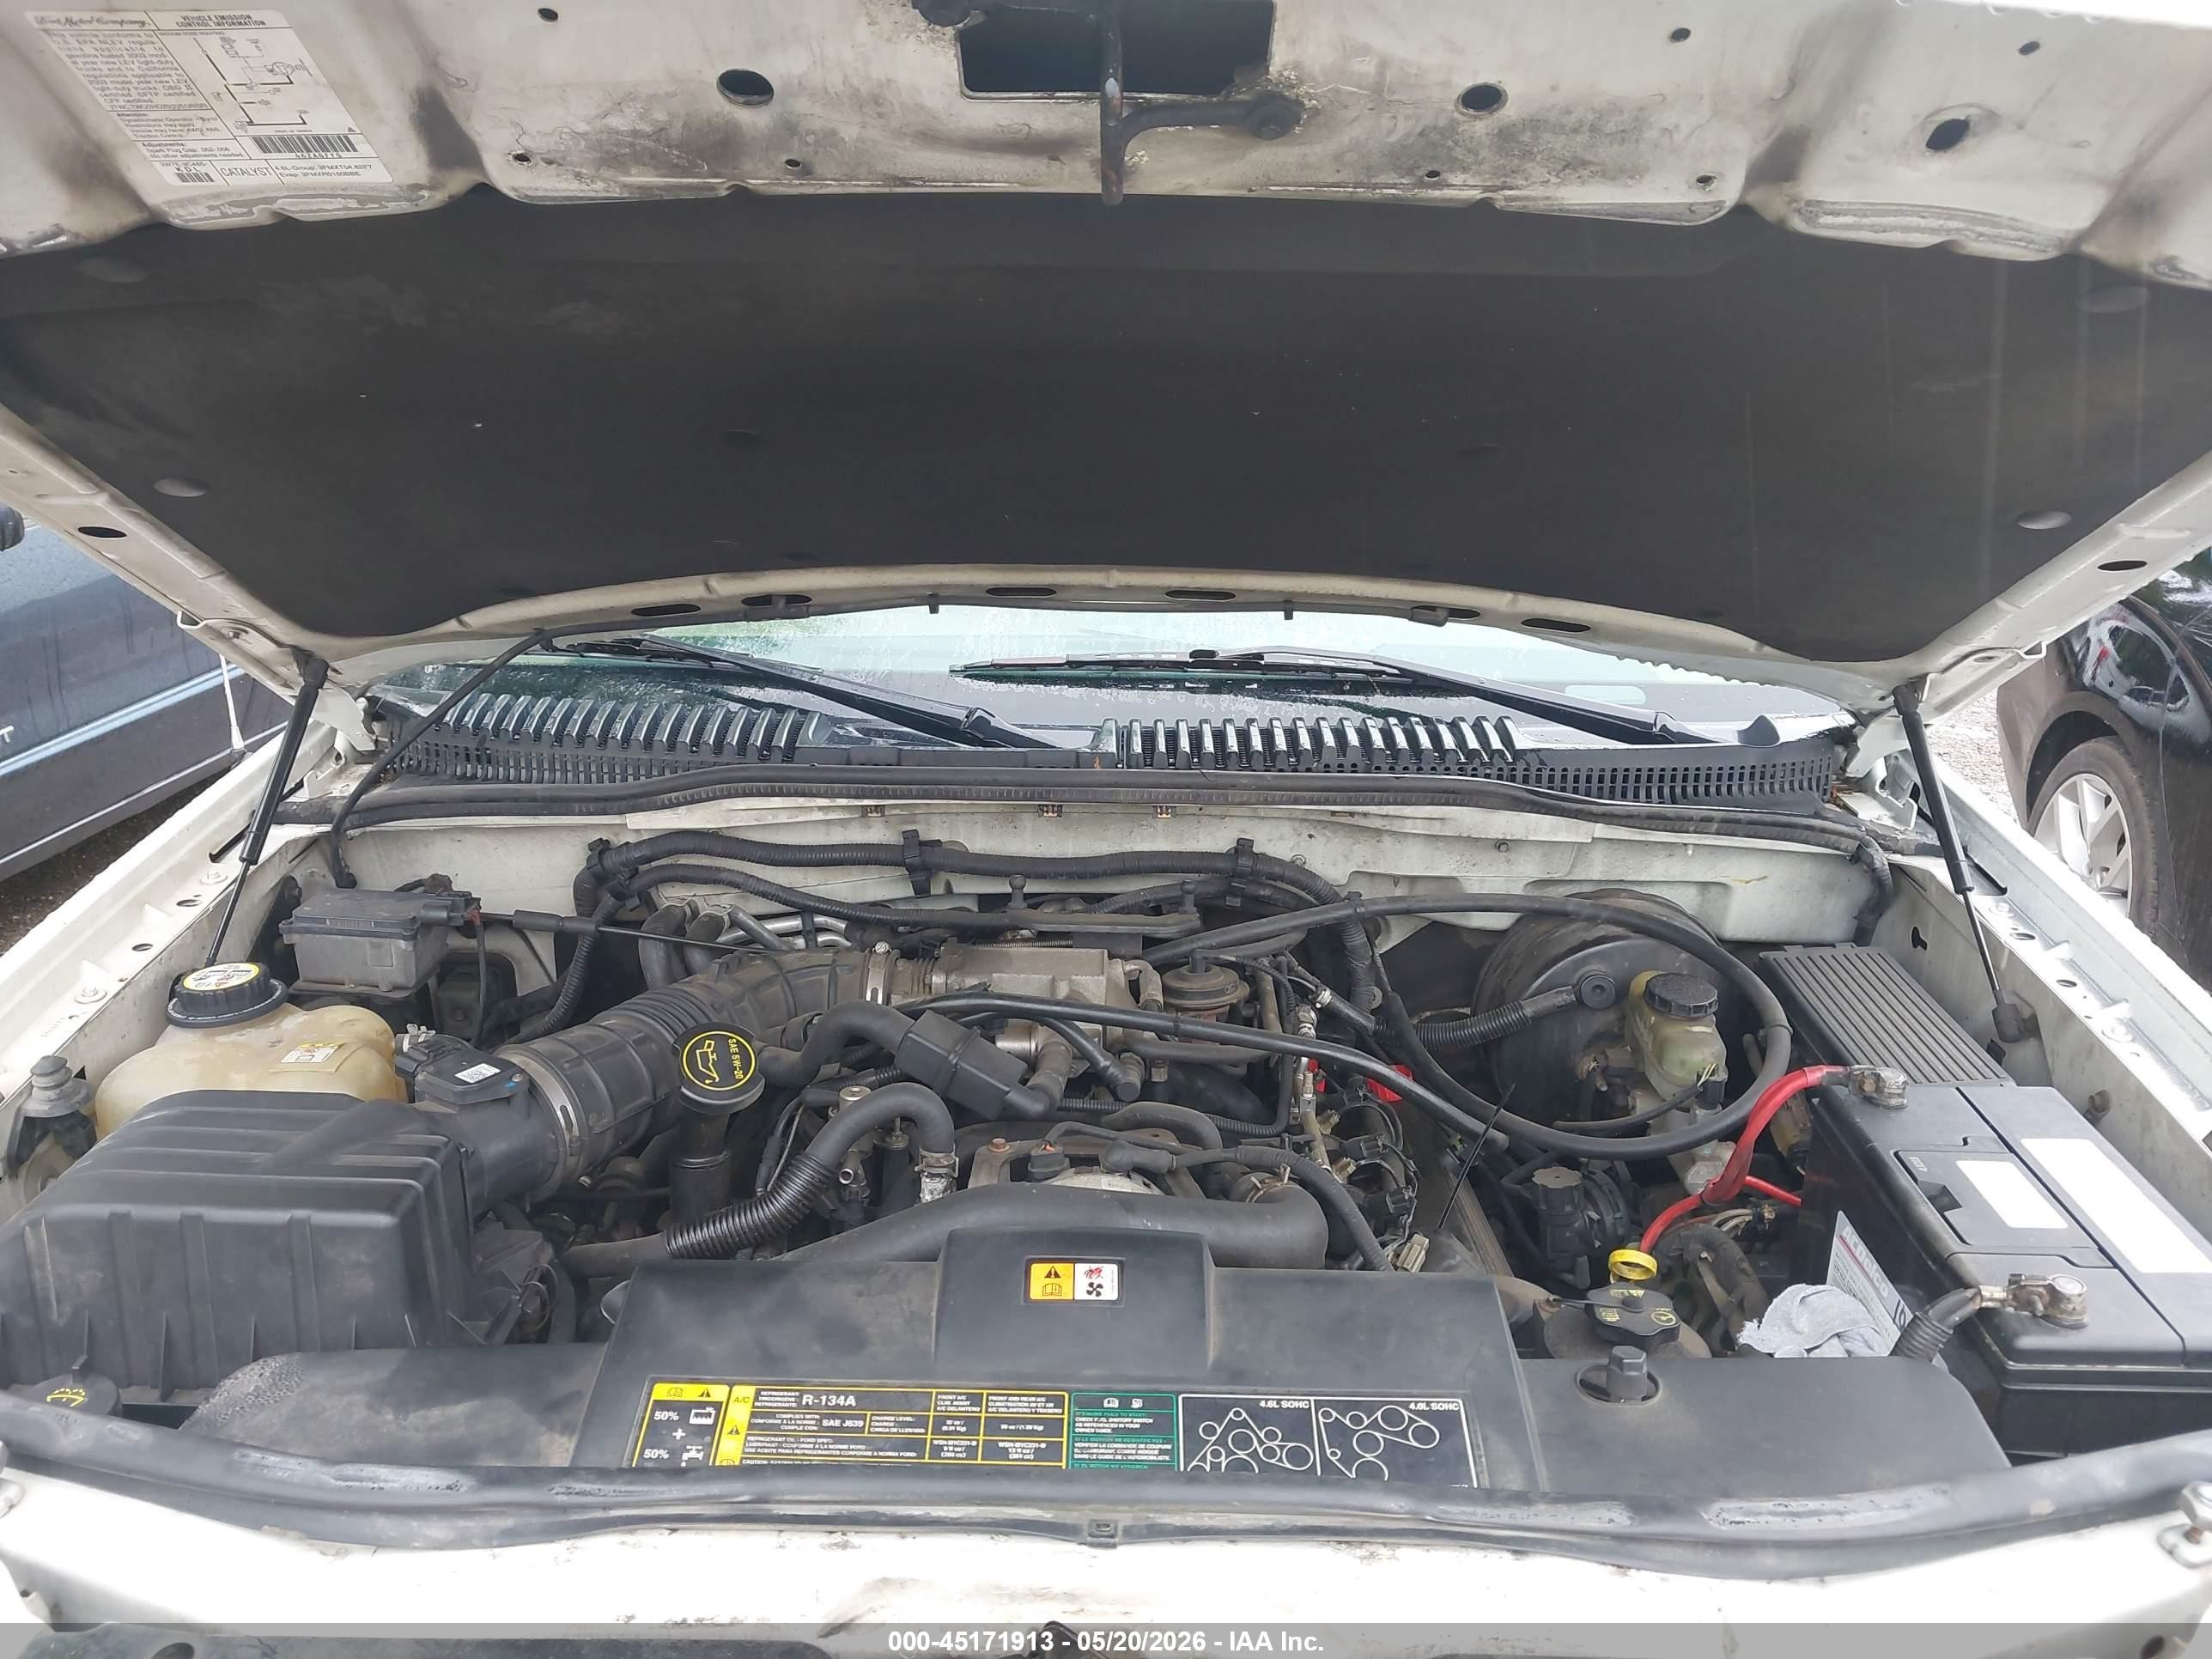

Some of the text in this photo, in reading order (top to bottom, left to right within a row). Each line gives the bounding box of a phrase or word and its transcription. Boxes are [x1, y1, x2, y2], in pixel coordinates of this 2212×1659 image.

[220, 167, 273, 177] CATALYST
[728, 1038, 744, 1079] SAE 5W-20
[802, 1394, 857, 1407] R-134A
[1259, 1400, 1310, 1409] 4.6L SOHC
[1409, 1402, 1460, 1411] 4.0L SOHC
[653, 1410, 680, 1421] 50%
[643, 1449, 669, 1460] 50%
